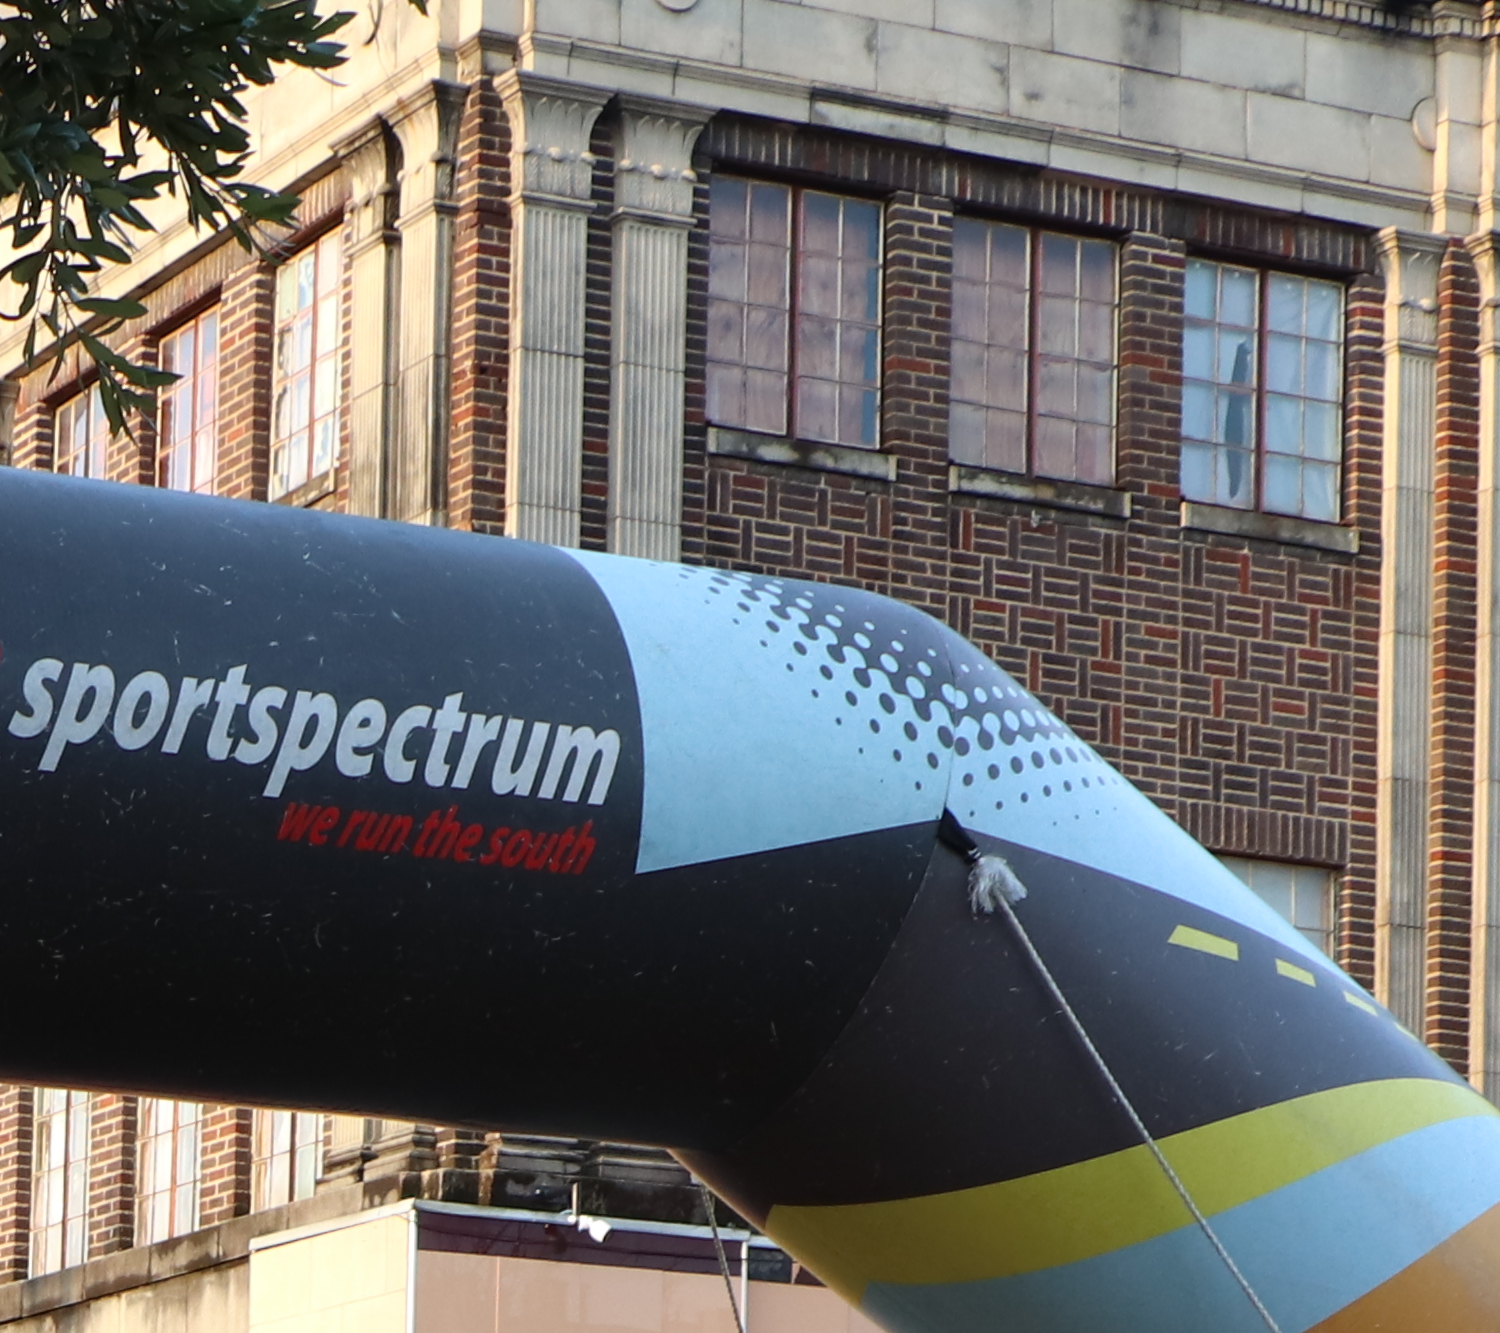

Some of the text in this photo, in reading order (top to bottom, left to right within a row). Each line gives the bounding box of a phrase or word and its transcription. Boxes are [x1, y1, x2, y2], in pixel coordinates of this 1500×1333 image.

[7, 657, 621, 806] sportspectrum
[277, 802, 597, 875] we run the south
